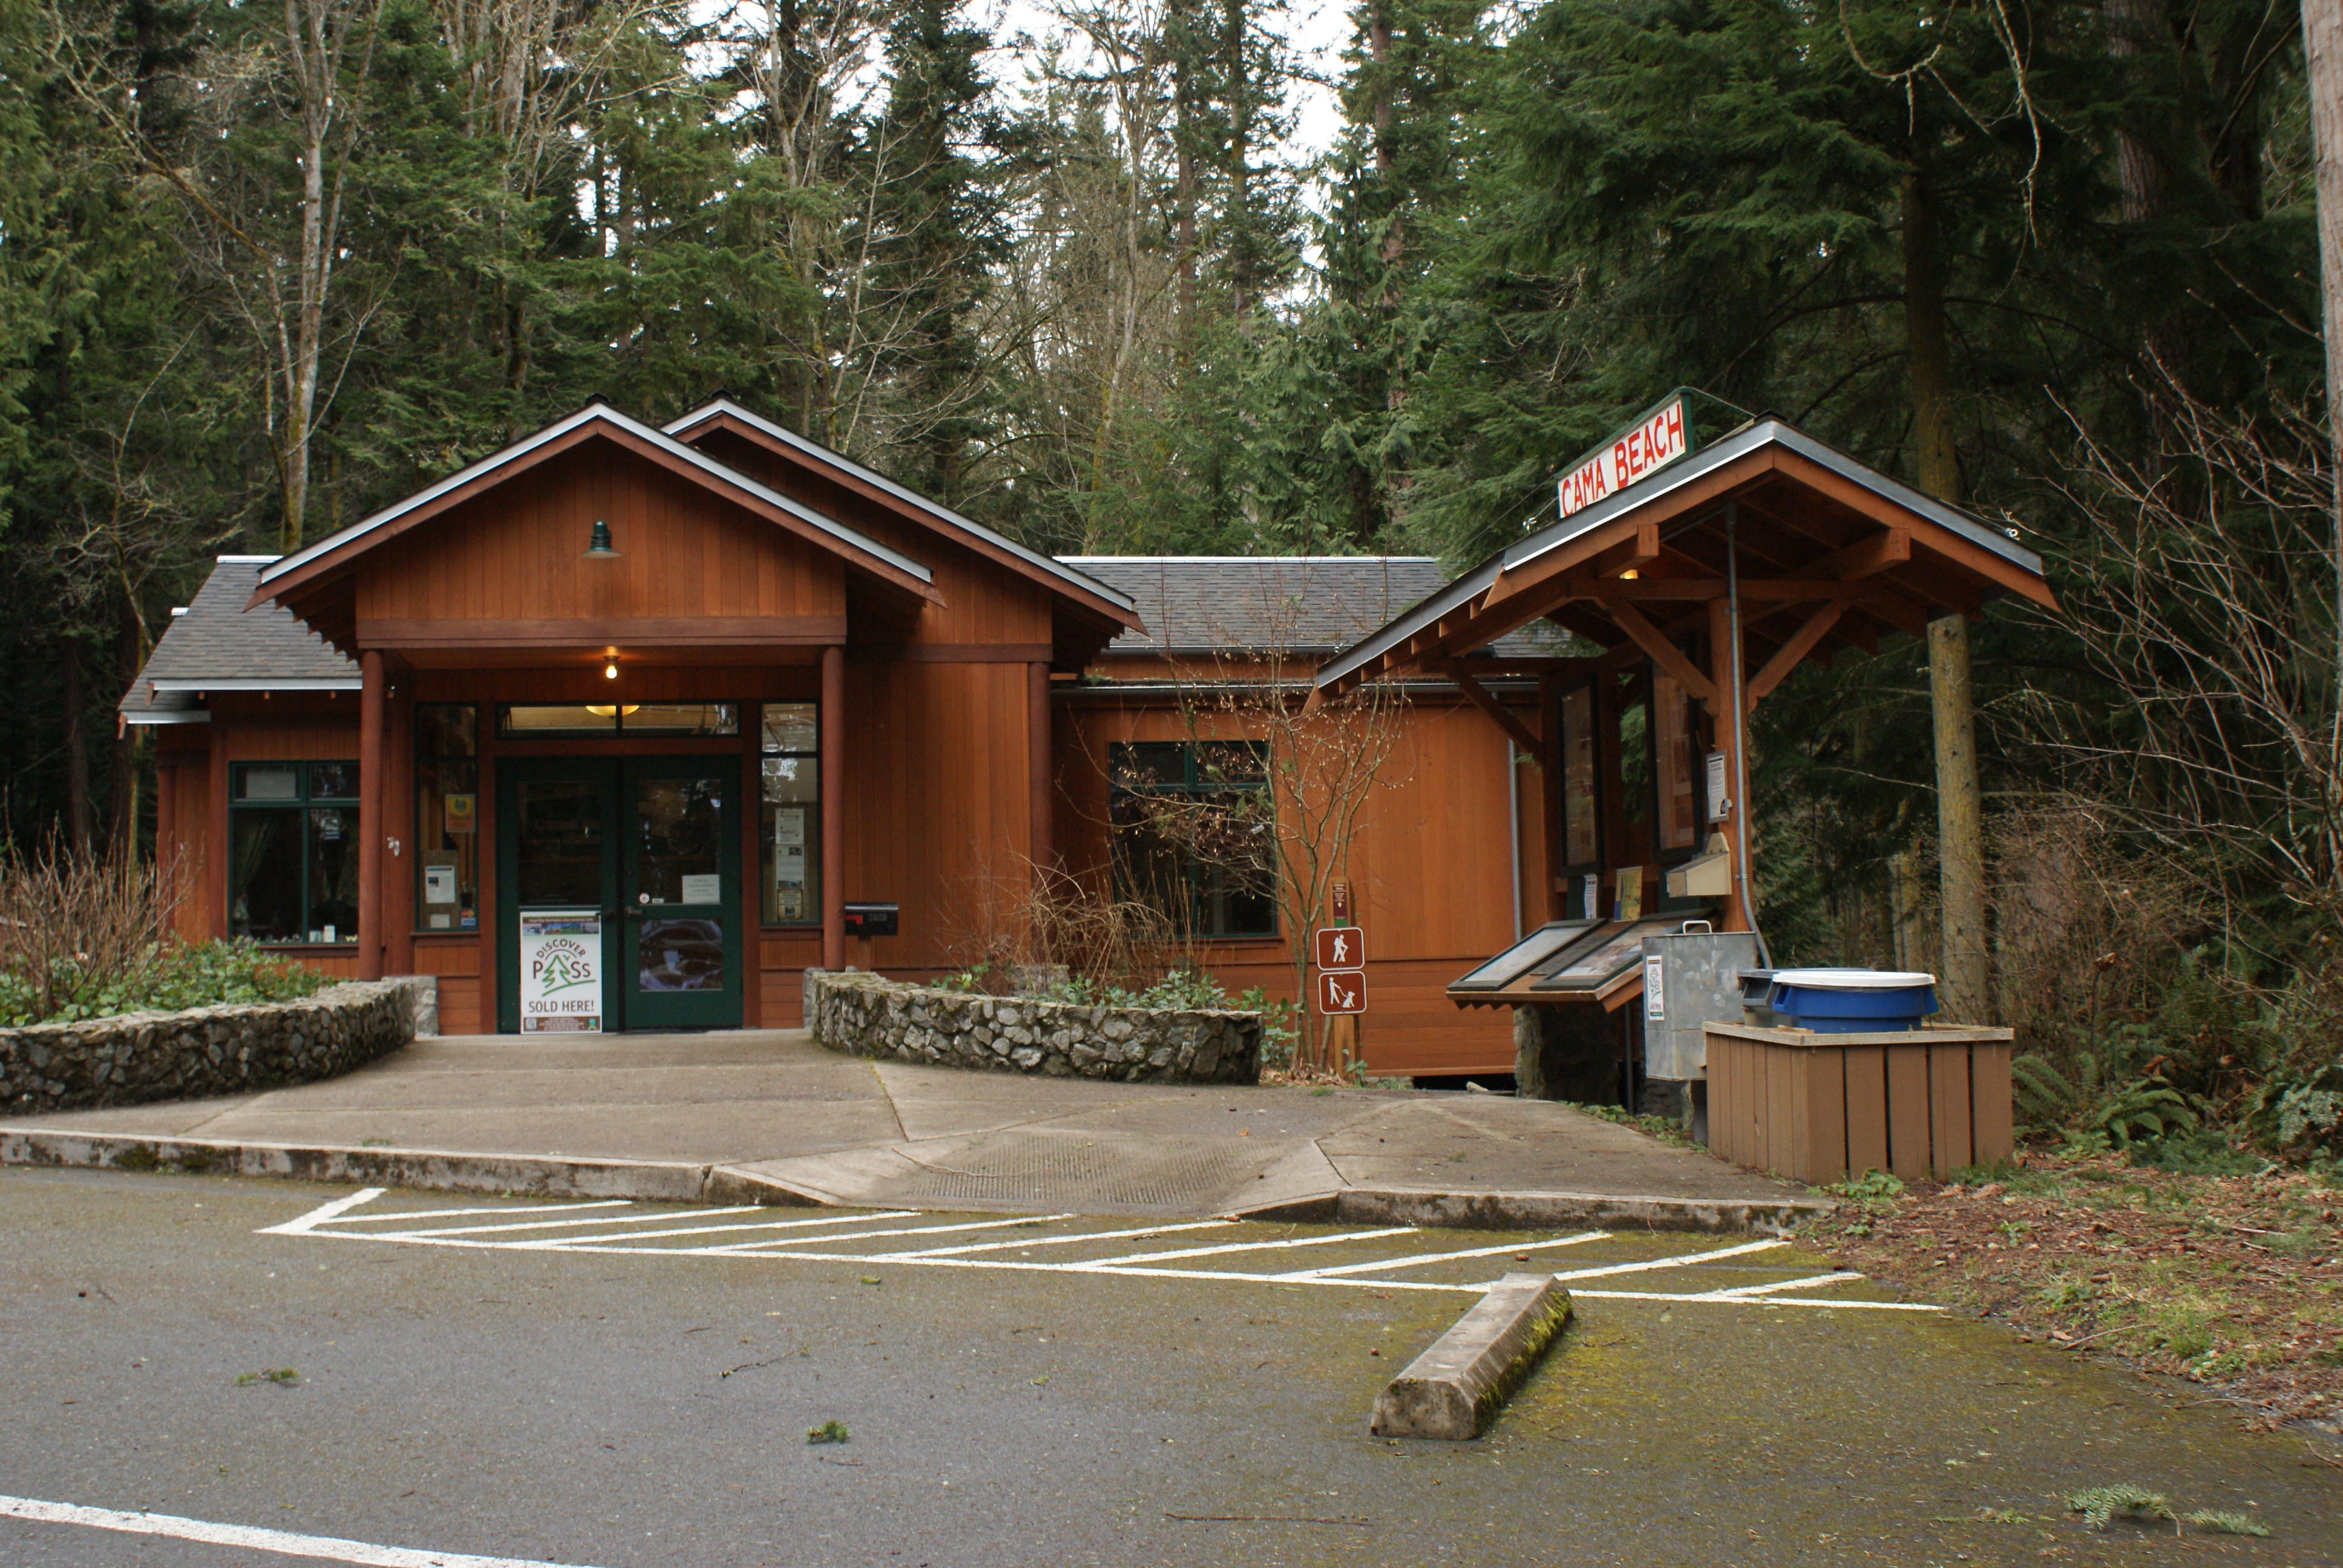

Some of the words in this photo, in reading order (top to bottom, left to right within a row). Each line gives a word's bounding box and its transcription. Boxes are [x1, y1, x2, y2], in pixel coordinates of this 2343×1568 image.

[1562, 457, 1607, 517] CAMA
[1614, 403, 1683, 490] BEACH
[536, 938, 586, 959] DISCOVER
[528, 1001, 558, 1013] SOLD
[562, 1000, 594, 1013] HERE!
